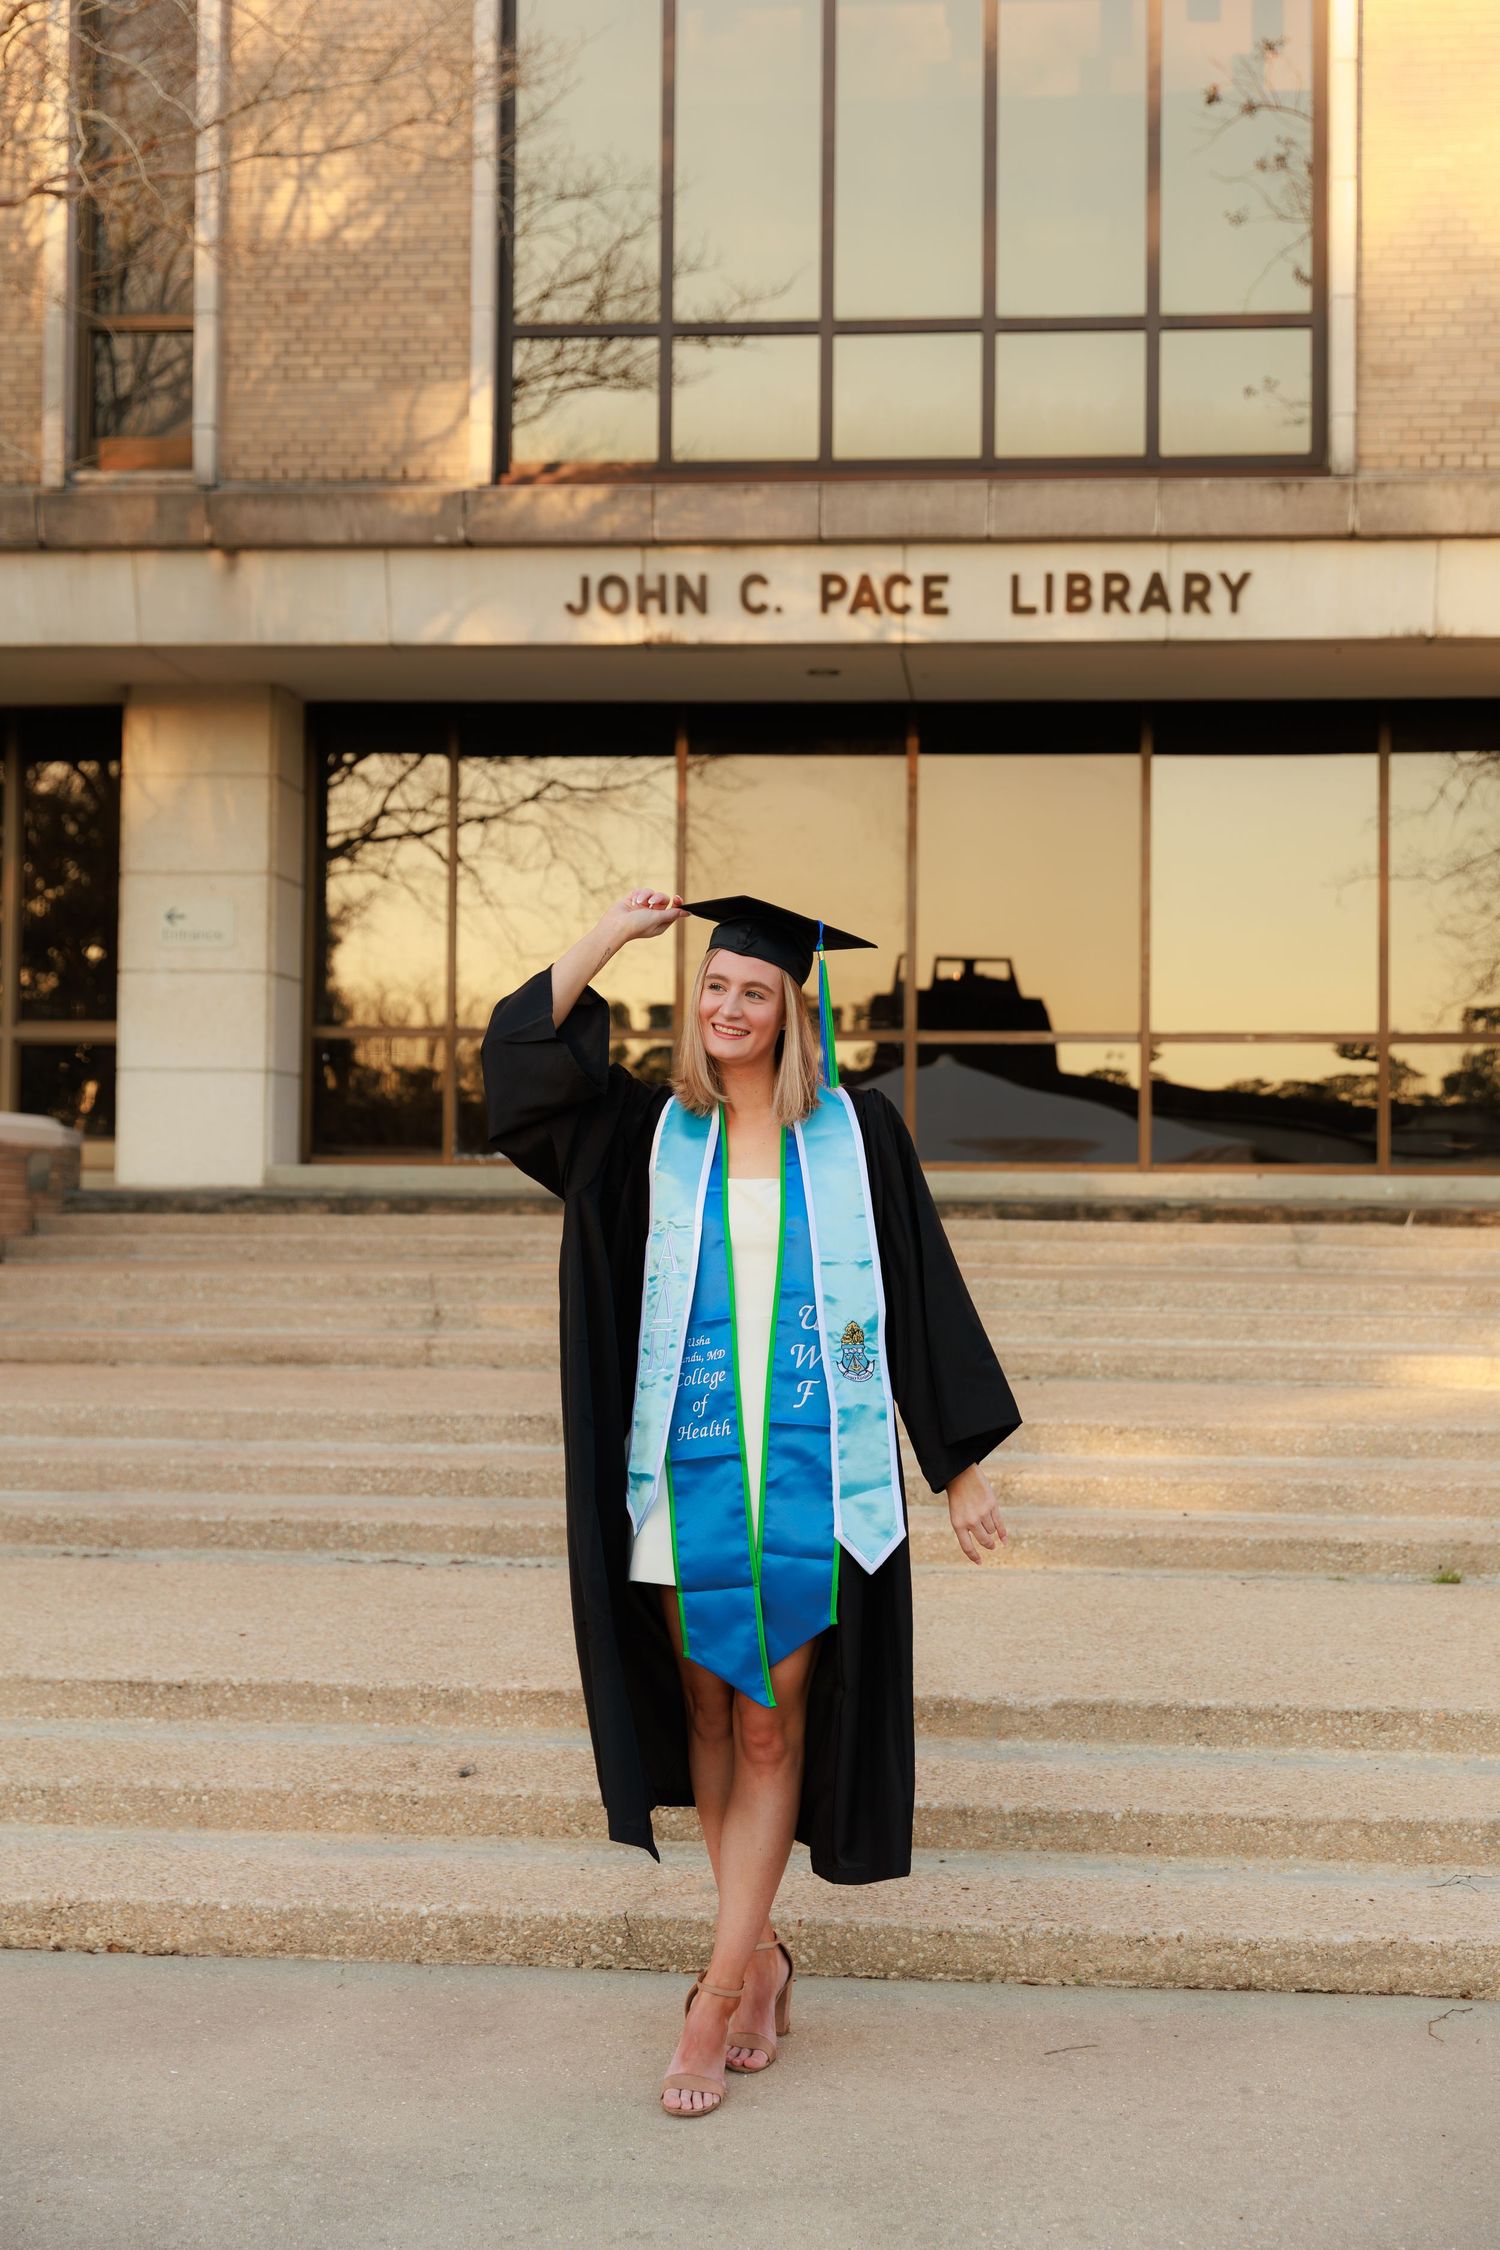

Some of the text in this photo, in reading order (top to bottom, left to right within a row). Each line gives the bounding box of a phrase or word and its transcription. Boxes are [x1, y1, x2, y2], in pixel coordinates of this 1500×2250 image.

[565, 572, 1251, 616] JOHN C. PACE LIBRARY
[686, 1334, 711, 1347] Usha
[706, 1348, 726, 1361] MD
[692, 1393, 709, 1418] of
[677, 1418, 731, 1441] Health
